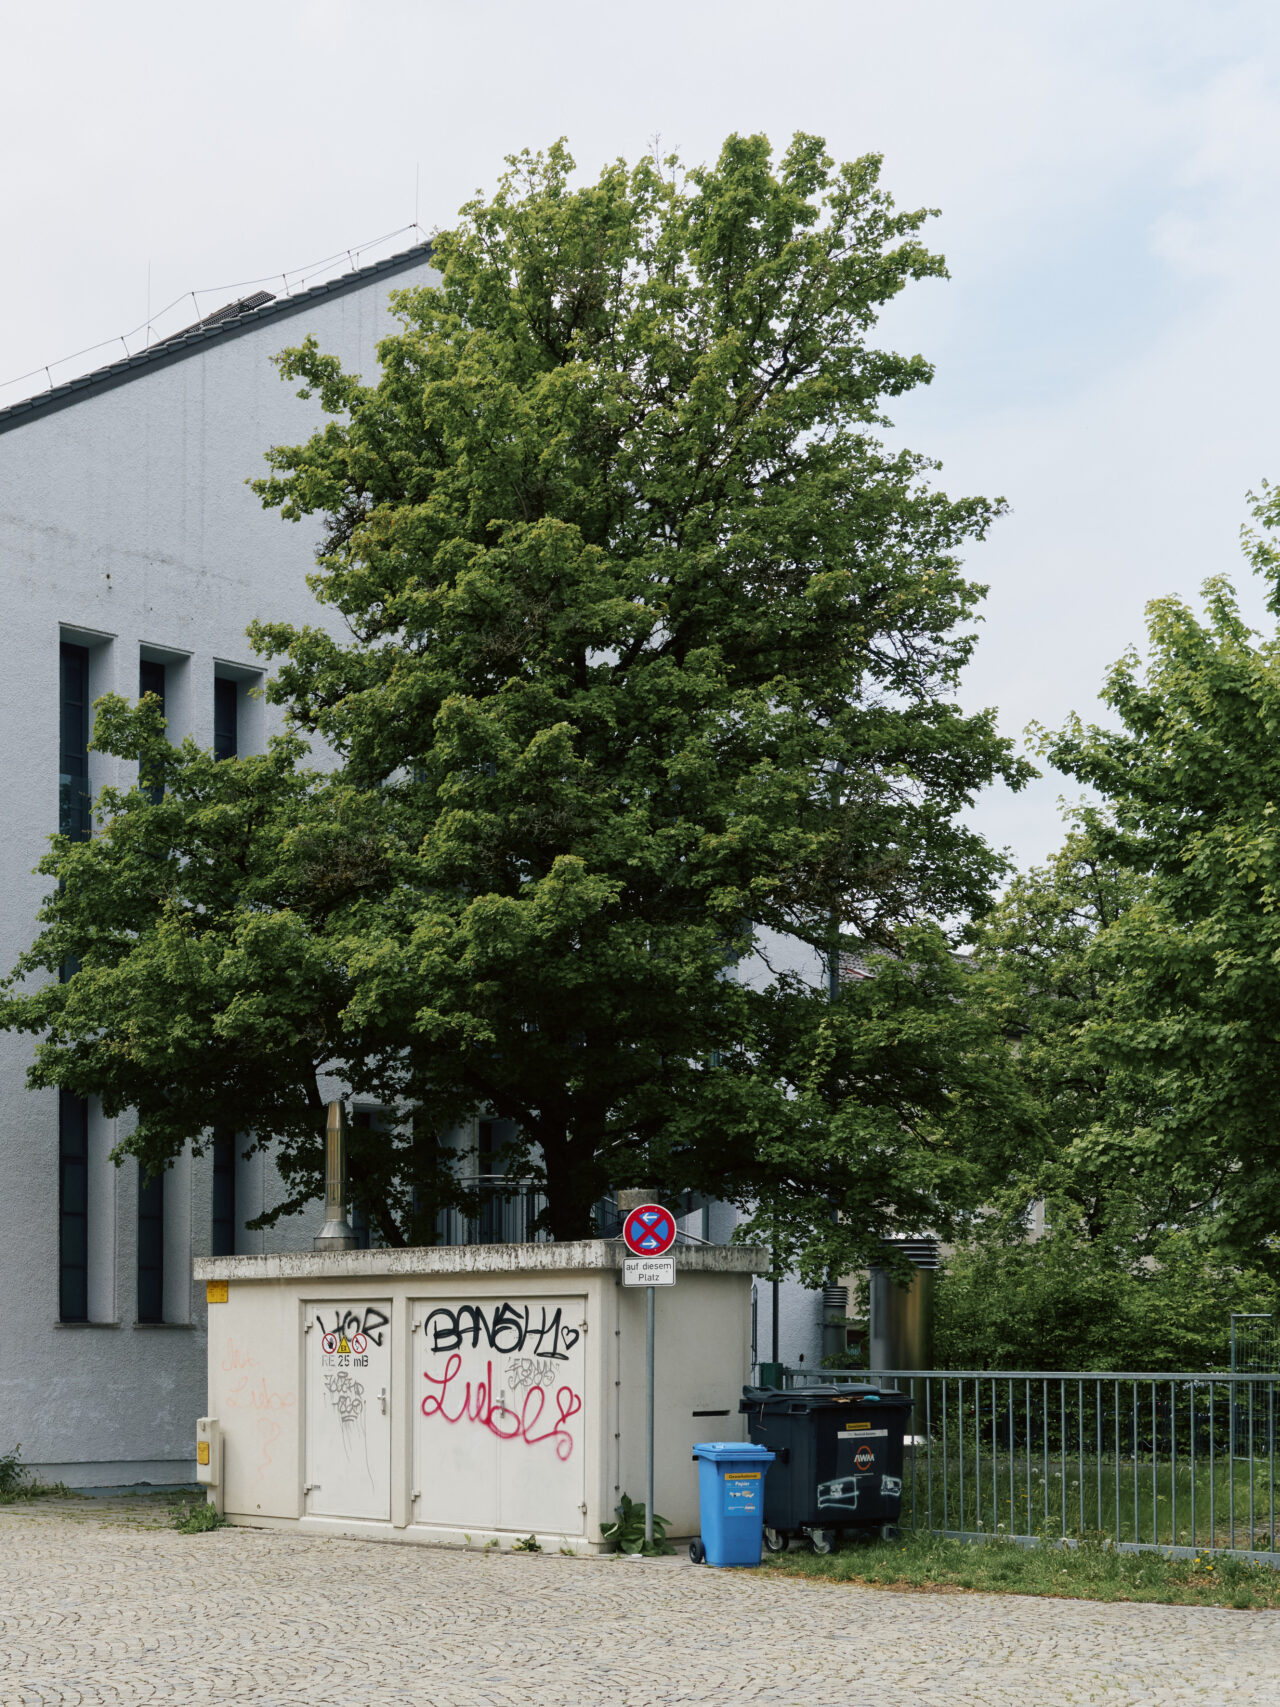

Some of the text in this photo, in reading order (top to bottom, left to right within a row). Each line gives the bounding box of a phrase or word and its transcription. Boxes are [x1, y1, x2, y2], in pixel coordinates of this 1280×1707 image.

[626, 1261, 672, 1271] auf diesem
[638, 1273, 660, 1281] Platz
[337, 1354, 350, 1367] 25
[353, 1355, 369, 1367] mB
[853, 1453, 875, 1462] AWM
